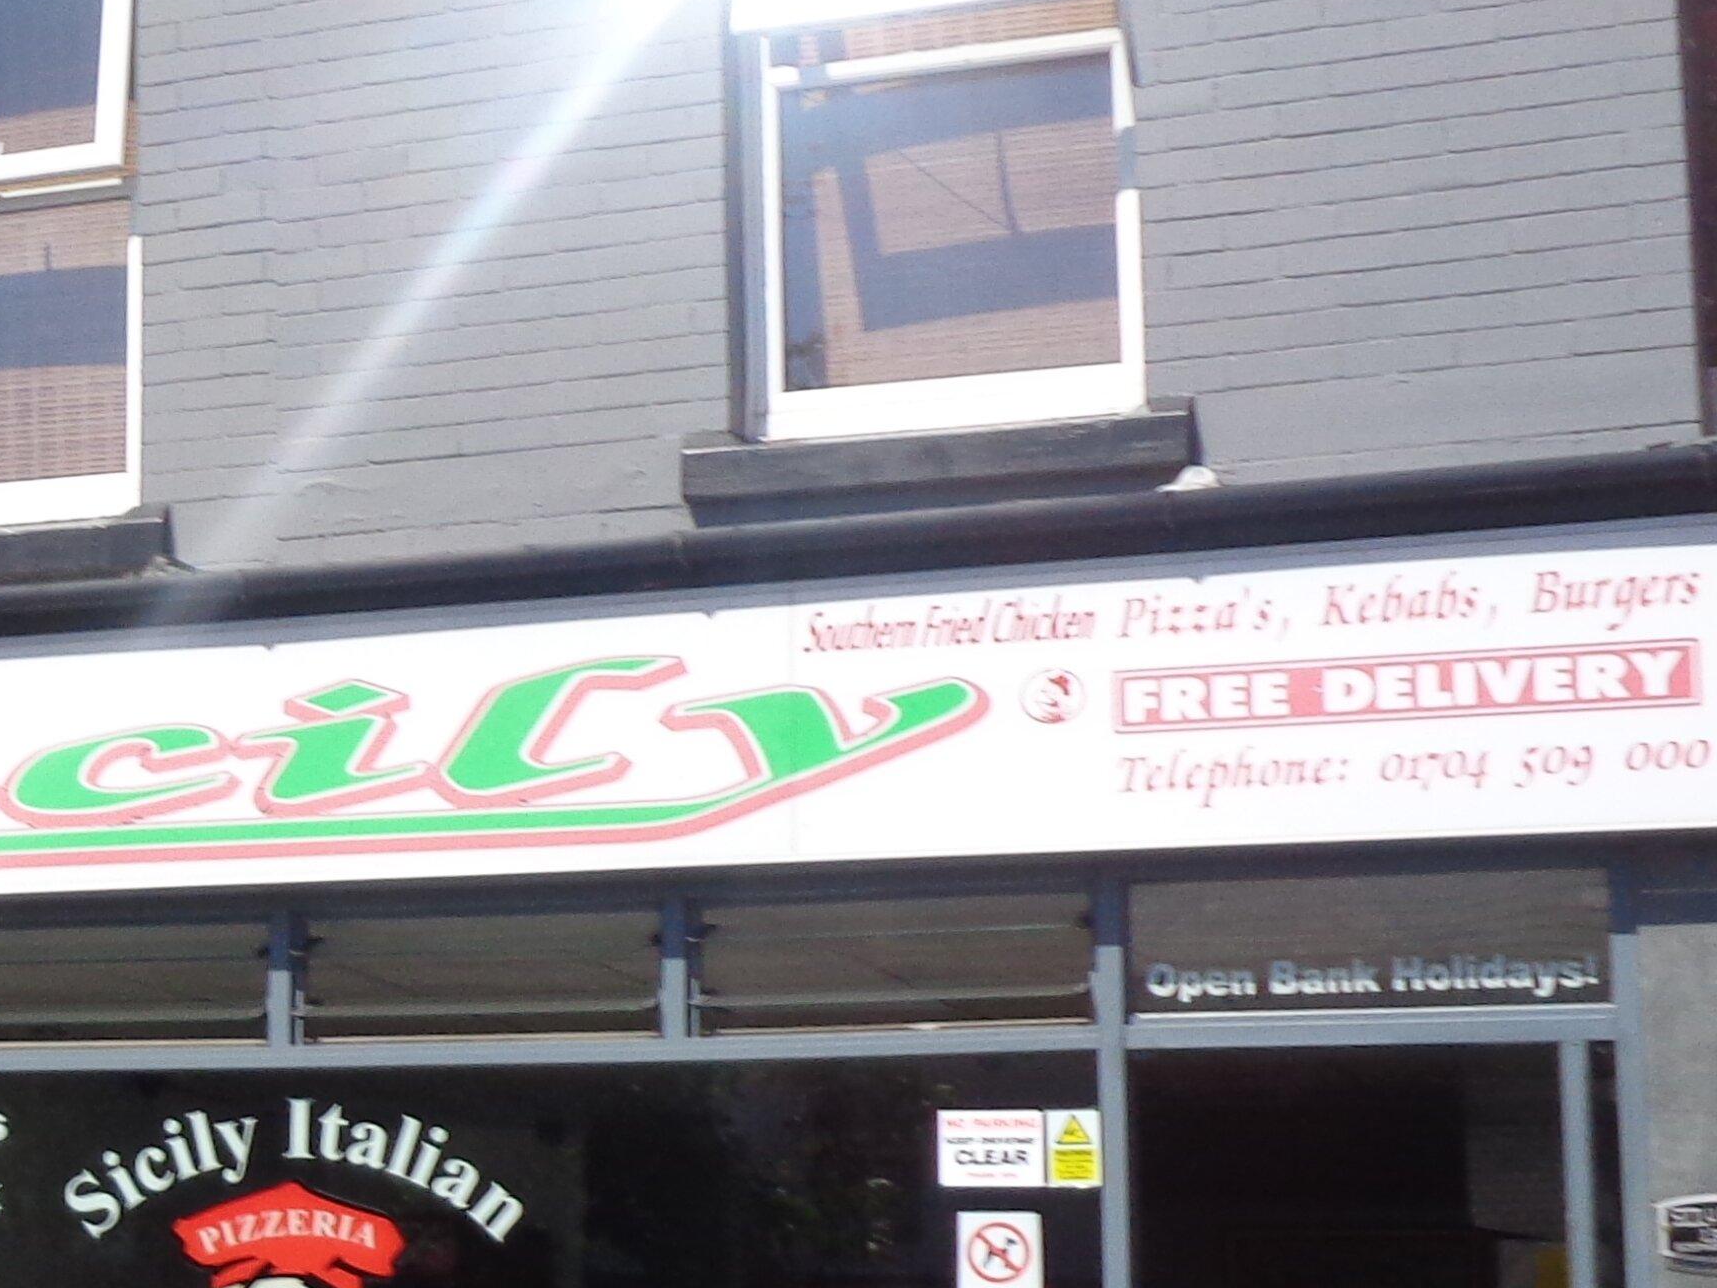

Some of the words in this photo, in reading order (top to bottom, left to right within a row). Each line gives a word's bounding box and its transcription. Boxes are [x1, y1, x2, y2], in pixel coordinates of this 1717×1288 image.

[803, 605, 916, 653] Southern
[921, 598, 992, 648] Fried
[993, 593, 1096, 644] Chicken
[1117, 585, 1290, 642] Pizza's,
[1319, 569, 1499, 629] Kebabs,
[1530, 570, 1701, 632] Burgers
[1123, 671, 1292, 724] FREE
[1321, 649, 1685, 713] DELIVERY
[1118, 745, 1350, 809] Telephone:
[1379, 748, 1493, 792] 01704
[1512, 745, 1596, 788] 509
[1623, 738, 1712, 772] 000
[1144, 961, 1258, 1004] Open
[1267, 958, 1383, 996] Bank
[1390, 953, 1601, 999] Holidays!
[63, 1108, 259, 1240] Sicily
[281, 1096, 526, 1244] Italian
[954, 1149, 1029, 1166] CLEAR
[195, 1208, 378, 1256] PIZZERIA
